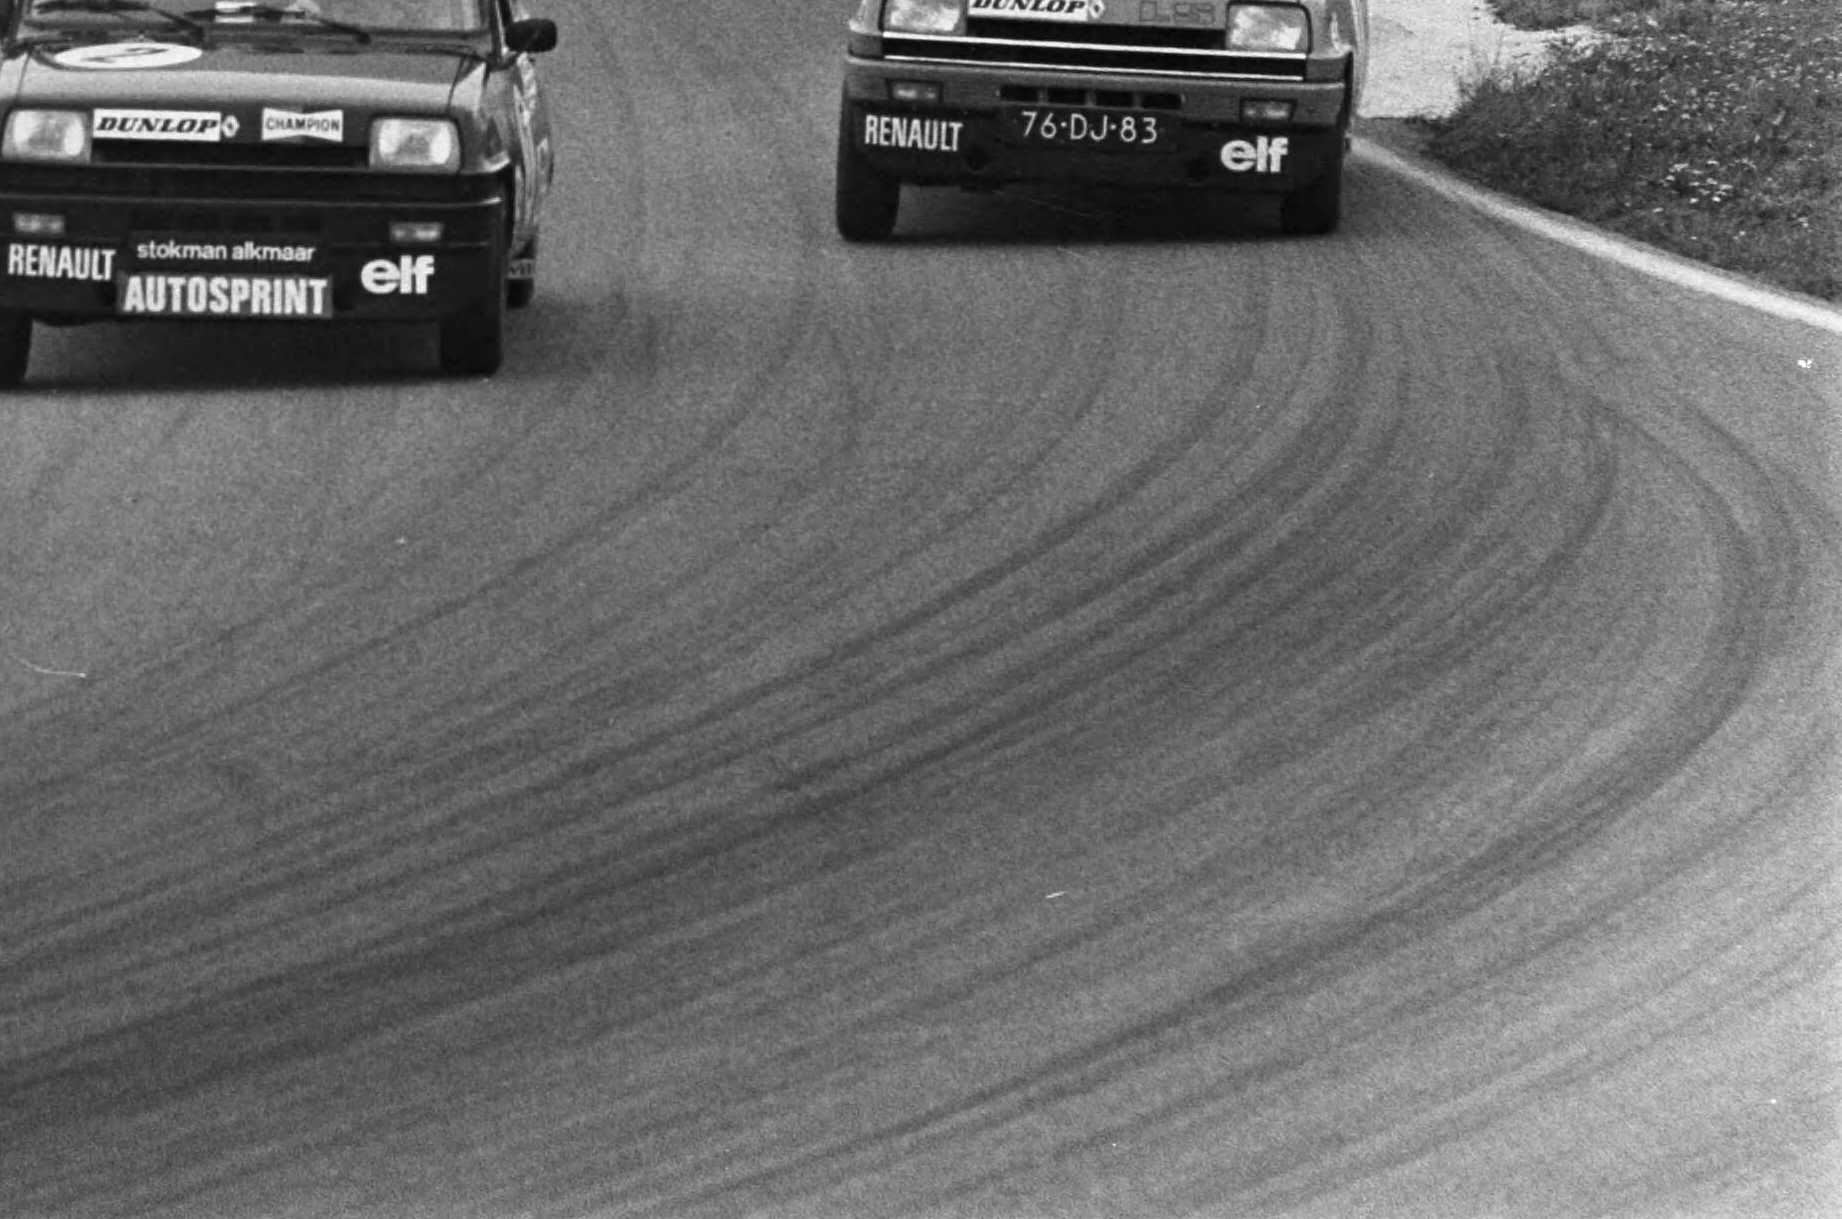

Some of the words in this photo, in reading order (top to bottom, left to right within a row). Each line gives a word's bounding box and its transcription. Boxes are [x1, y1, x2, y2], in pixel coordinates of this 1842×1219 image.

[80, 46, 170, 64] 2
[95, 116, 219, 134] DUNLOP
[265, 116, 341, 131] CHAMPION
[864, 114, 963, 152] RENAULT
[1021, 111, 1158, 144] 76-DJ-83
[1220, 135, 1289, 172] elf
[7, 243, 116, 281] RENAULT
[136, 240, 228, 261] stokman
[231, 241, 316, 262] alkmaar
[360, 255, 435, 294] elf
[122, 275, 328, 316] AUTOSPRINT
